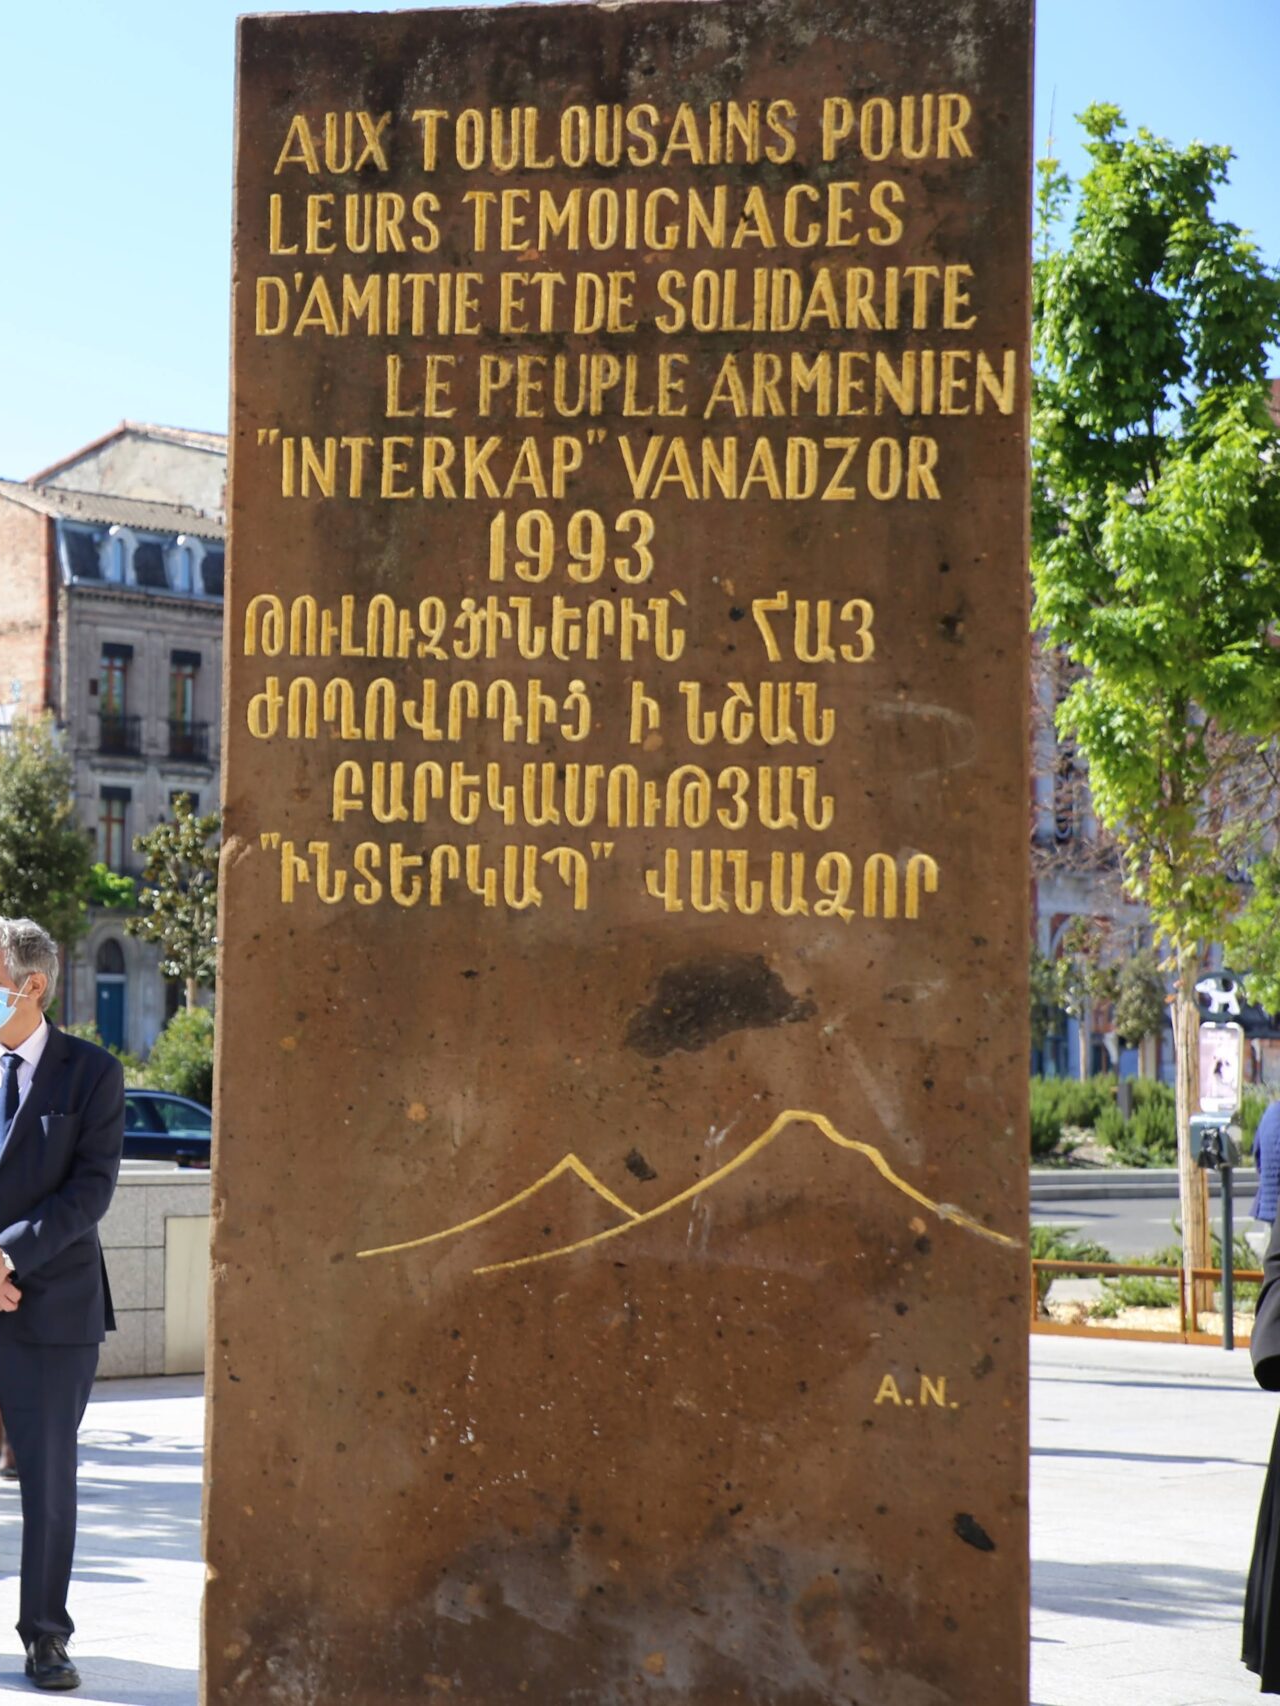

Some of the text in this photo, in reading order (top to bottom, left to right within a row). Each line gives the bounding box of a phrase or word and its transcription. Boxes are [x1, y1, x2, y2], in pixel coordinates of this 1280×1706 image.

[273, 92, 973, 175] AUX TOULOUSAINS POUR
[269, 191, 441, 256] LEURS
[255, 264, 978, 337] D'AMITIE ET DE SOLIDARITE
[385, 349, 1017, 419] LE PEUPLE ARMENIEN
[257, 428, 942, 501] "INTERKAP" VANADZOR
[488, 508, 656, 584] 1993
[751, 590, 876, 664] ՀԱՅ
[246, 675, 837, 747] ԺՈՂՈՎՐԴԻՑ Ի ՆՇԱՆ
[332, 760, 835, 831] ԲԱՐԵԿԱՄՈՒԹՅԱՆ
[645, 847, 941, 925] ՎԱՆԱՁՈՐ
[873, 1373, 959, 1409] A.N.
